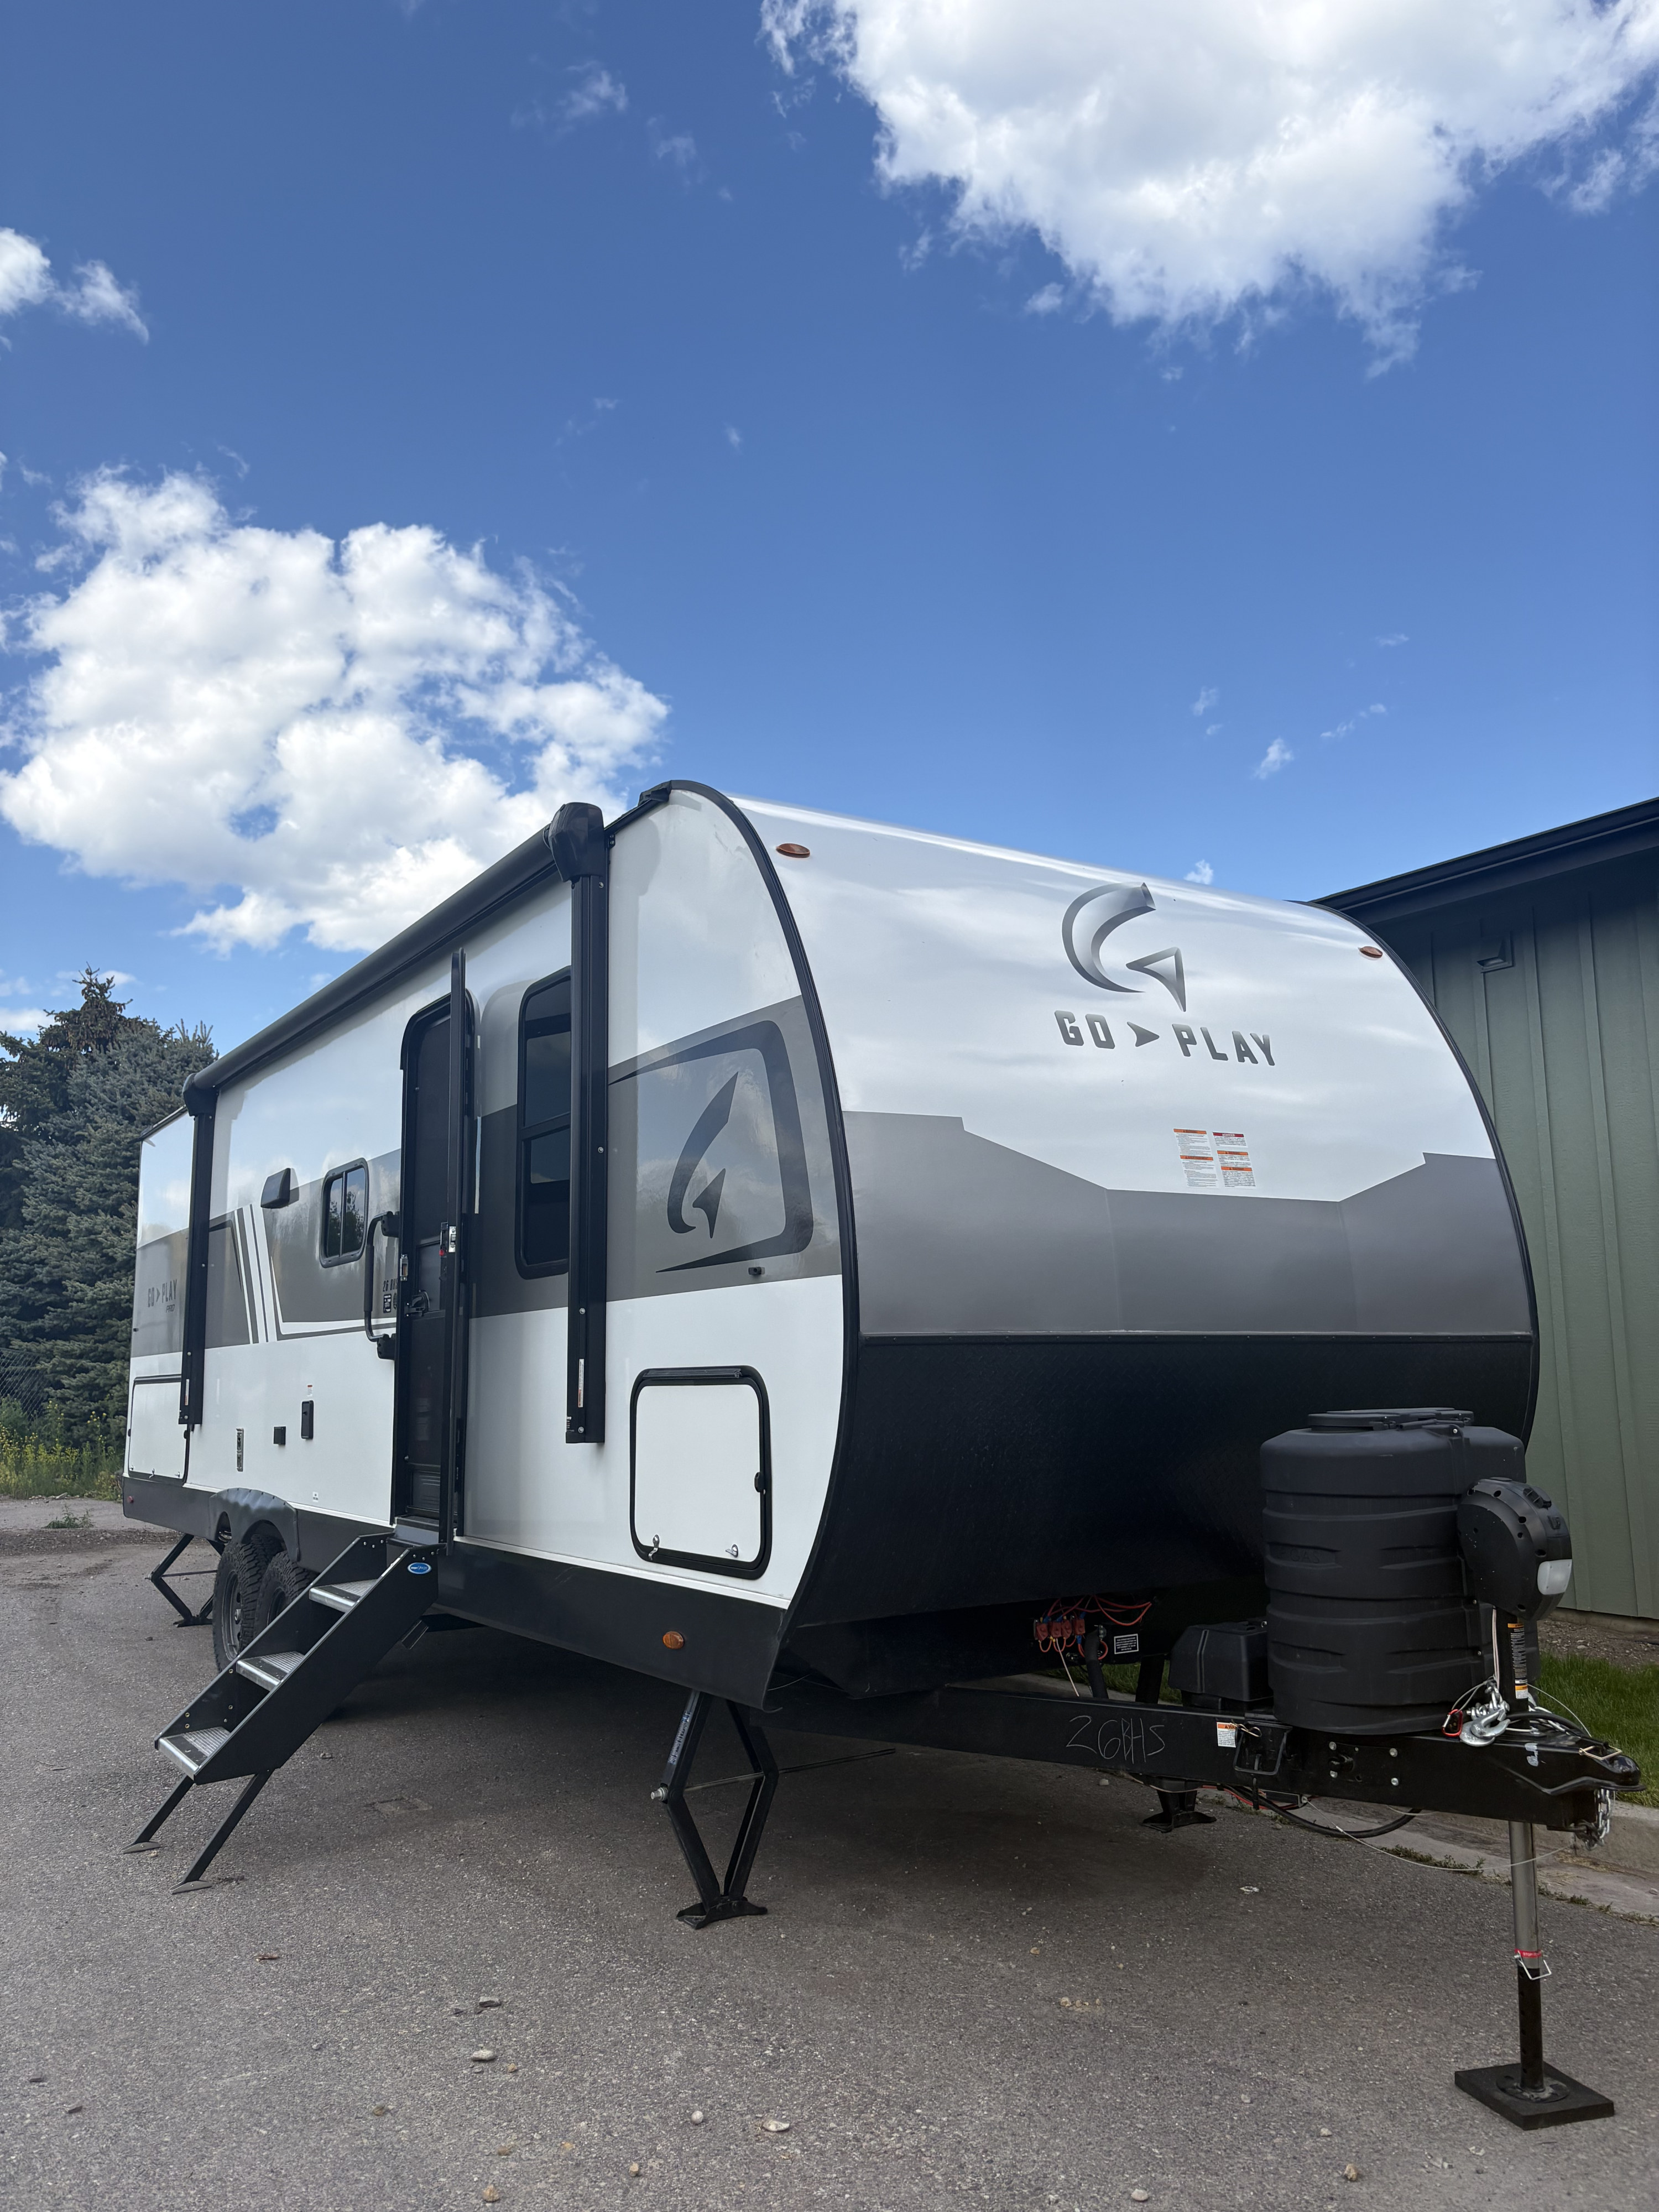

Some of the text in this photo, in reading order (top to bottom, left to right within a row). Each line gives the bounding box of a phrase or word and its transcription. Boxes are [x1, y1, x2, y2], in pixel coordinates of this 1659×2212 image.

[1055, 1010, 1275, 1066] GO PLAY
[148, 1279, 177, 1307] GO PLAY
[383, 1280, 389, 1292] 26
[166, 1304, 175, 1313] PRO
[1066, 1715, 1165, 1764] 26BHS
